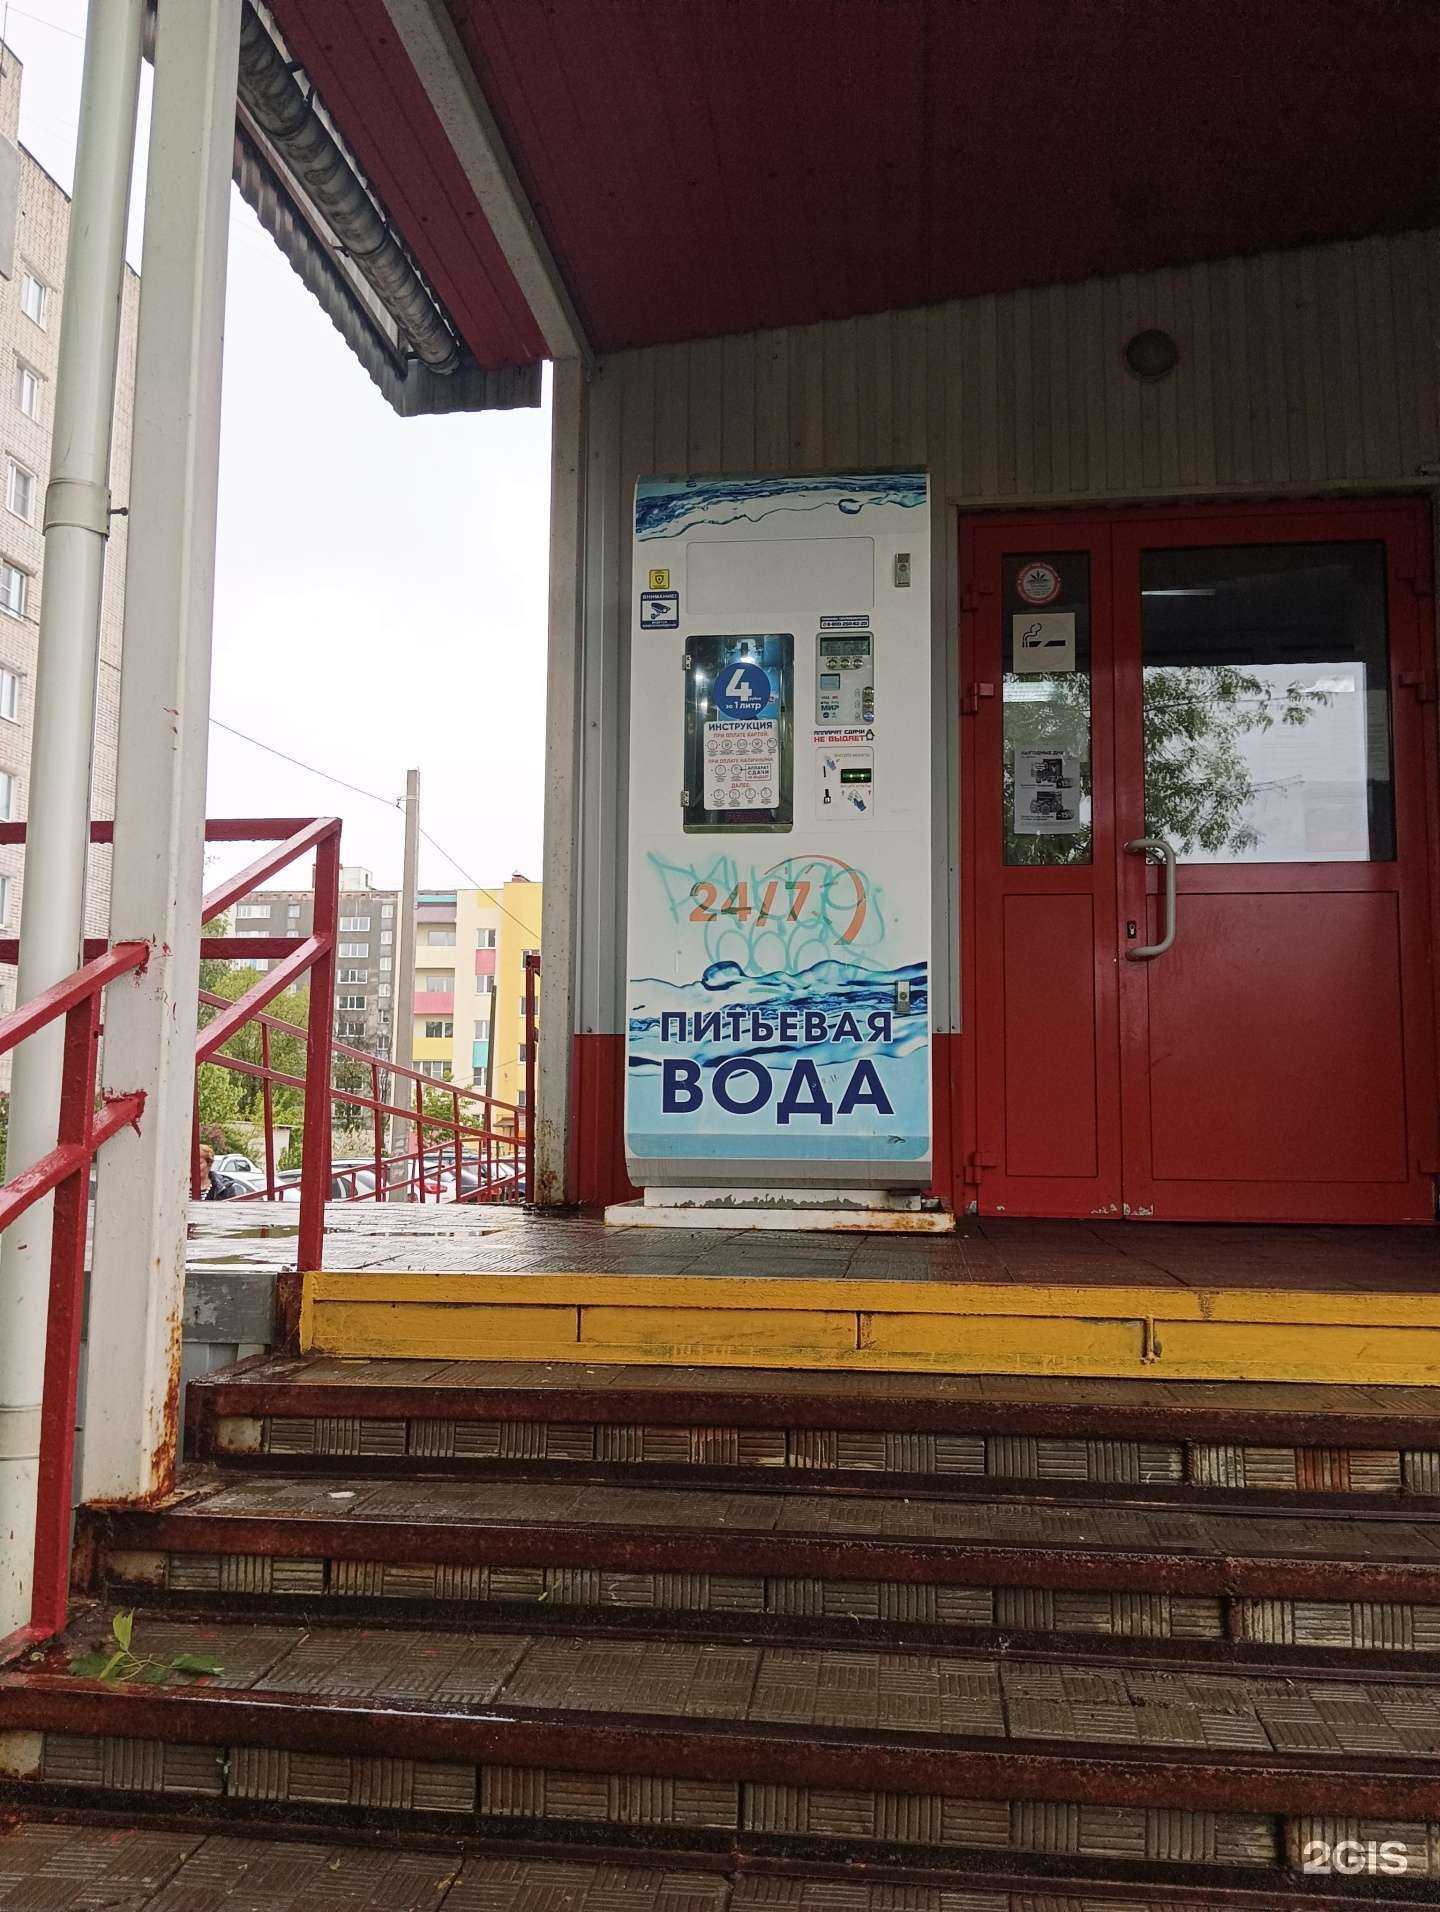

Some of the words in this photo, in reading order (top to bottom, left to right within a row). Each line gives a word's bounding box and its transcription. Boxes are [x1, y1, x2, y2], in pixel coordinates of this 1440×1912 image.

[726, 668, 752, 702] 4
[734, 701, 739, 709] 1
[740, 702, 761, 710] литр
[708, 722, 773, 731] ИНСТРУКЦИЯ
[689, 881, 811, 927] 24/7
[660, 1011, 893, 1042] ПИТЬЕВАЯ
[662, 1057, 895, 1125] ВОДА
